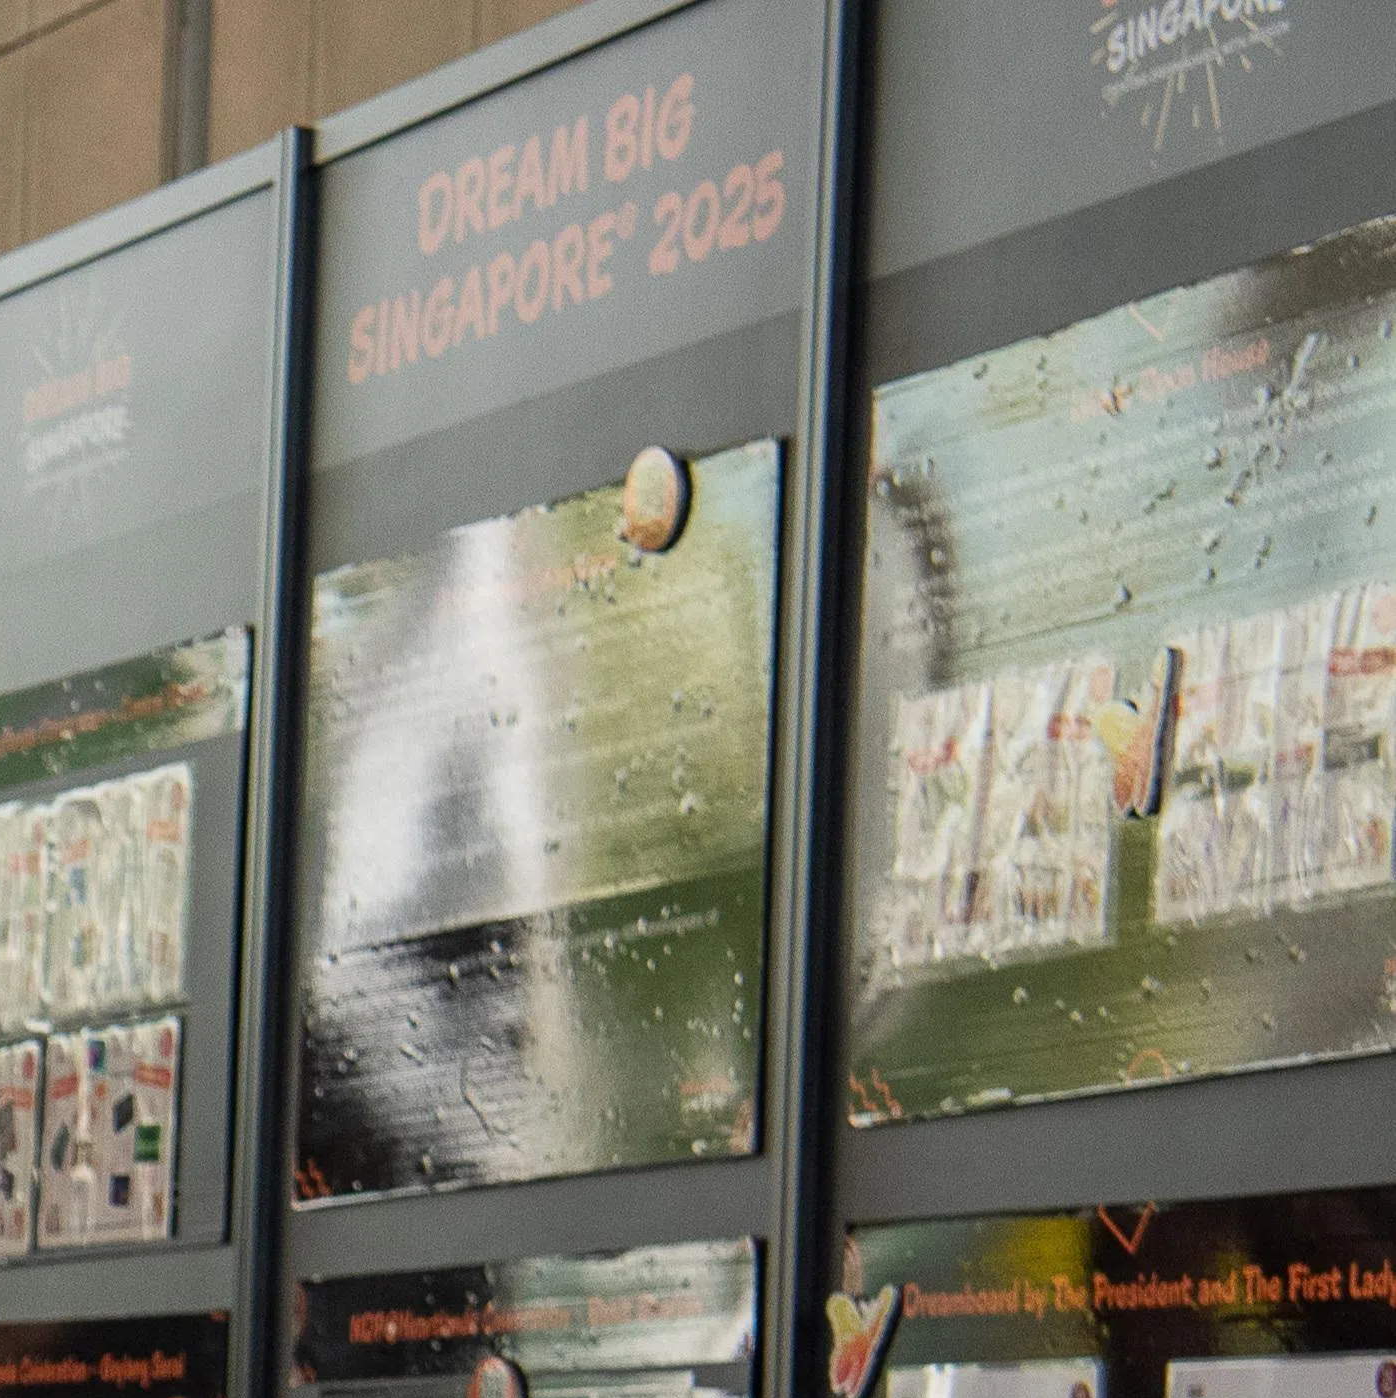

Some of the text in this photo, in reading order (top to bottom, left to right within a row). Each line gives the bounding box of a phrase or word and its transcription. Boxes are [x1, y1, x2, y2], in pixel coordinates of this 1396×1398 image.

[418, 73, 696, 256] DREAM BIG
[648, 149, 786, 276] 2025
[1052, 1273, 1088, 1313] The
[1092, 1271, 1193, 1310] President
[1198, 1269, 1236, 1306] and
[1242, 1264, 1283, 1304] The
[1288, 1262, 1341, 1302] First
